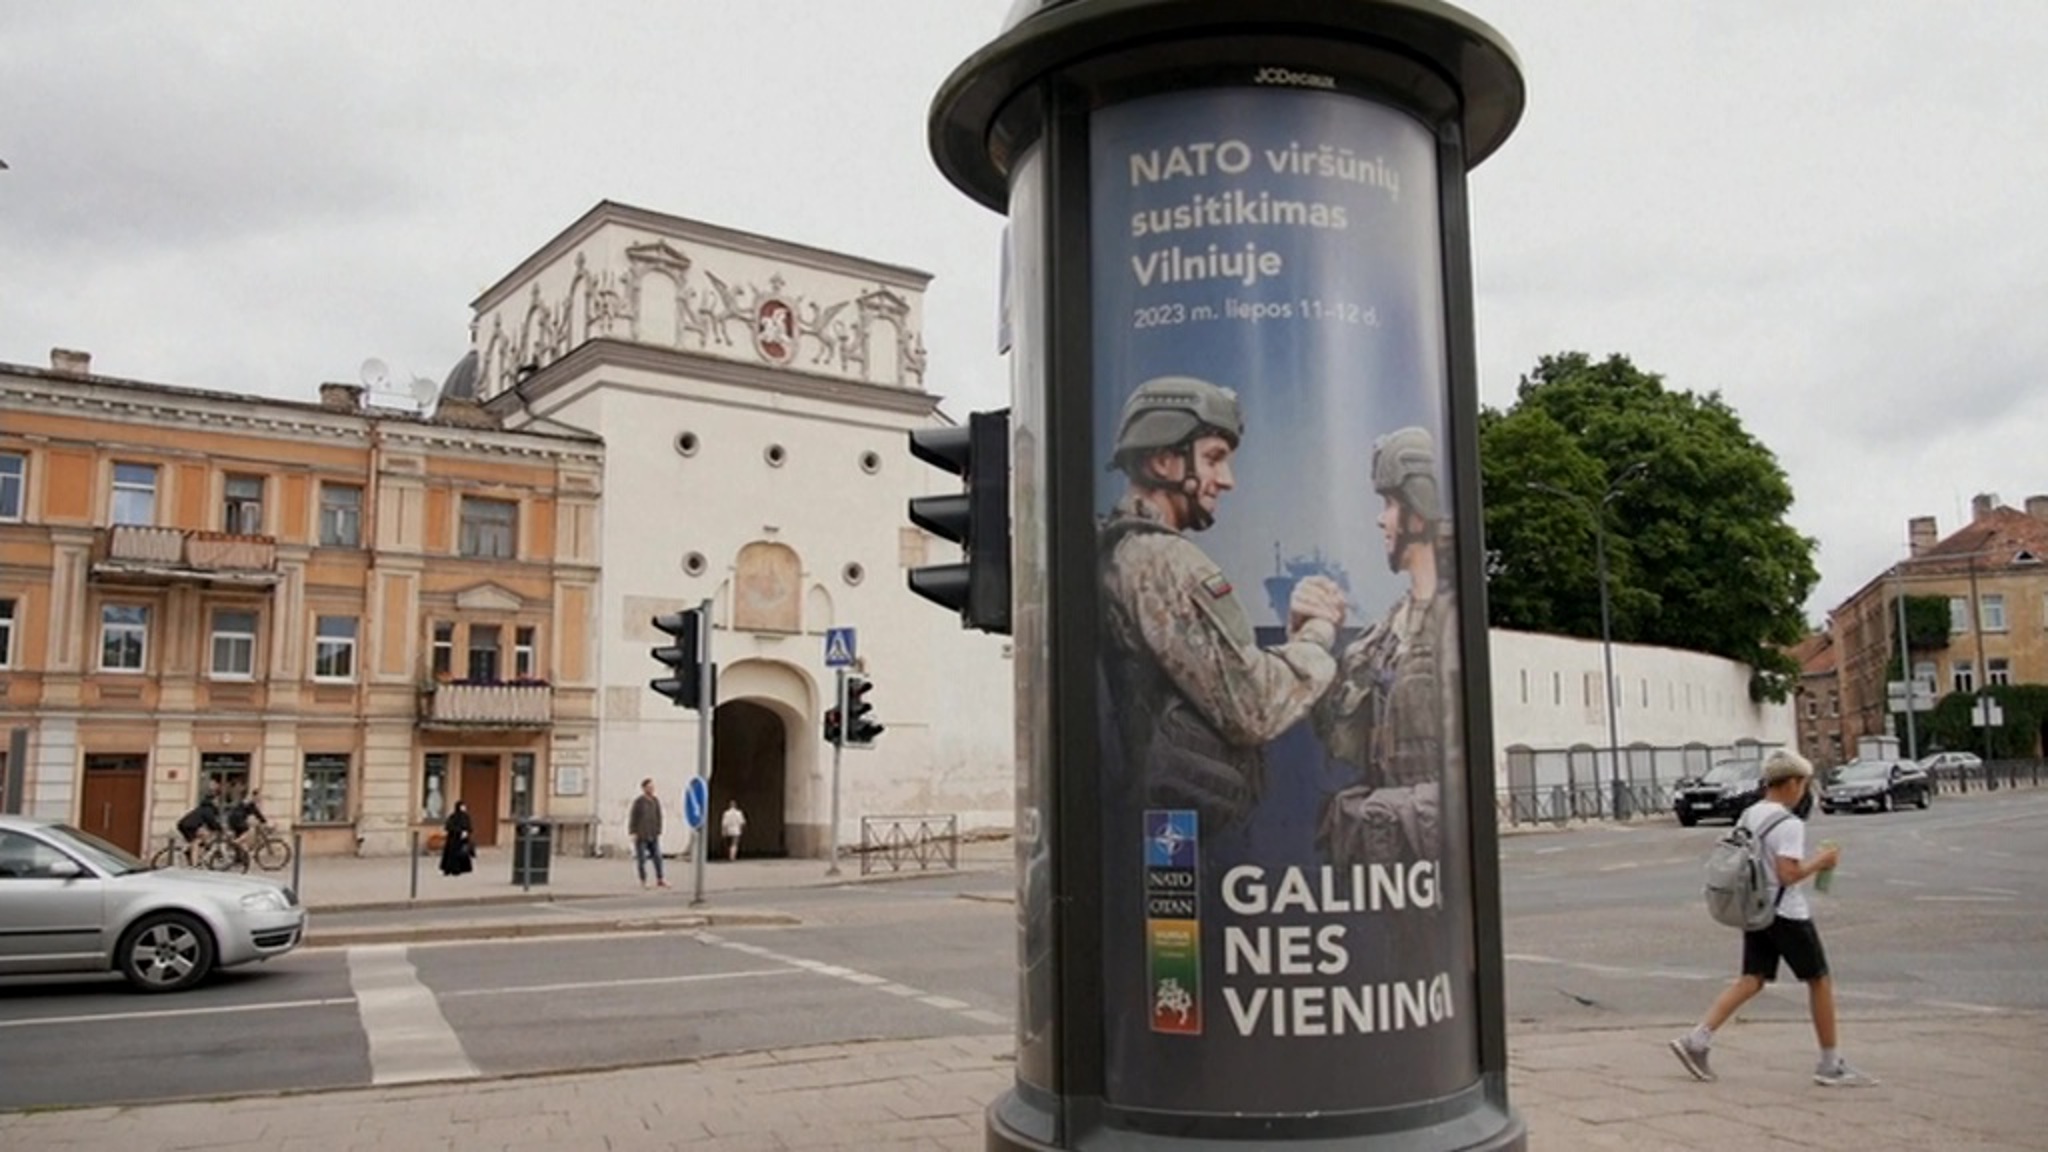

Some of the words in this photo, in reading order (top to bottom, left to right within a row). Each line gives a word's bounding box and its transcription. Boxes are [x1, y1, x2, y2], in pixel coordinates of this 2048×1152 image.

[1254, 67, 1336, 89] JCDecaux
[1130, 139, 1252, 187] NATO
[1266, 141, 1401, 202] viršūnių
[1131, 190, 1349, 237] susitikimas
[1131, 242, 1283, 287] Vilniuje
[1133, 303, 1185, 329] 2023
[1190, 305, 1219, 321] m.
[1225, 299, 1293, 324] liepos
[1150, 872, 1193, 888] NATO
[1150, 899, 1193, 914] OTAN
[1224, 924, 1349, 975] NES
[1222, 972, 1454, 1036] VIENINGI
